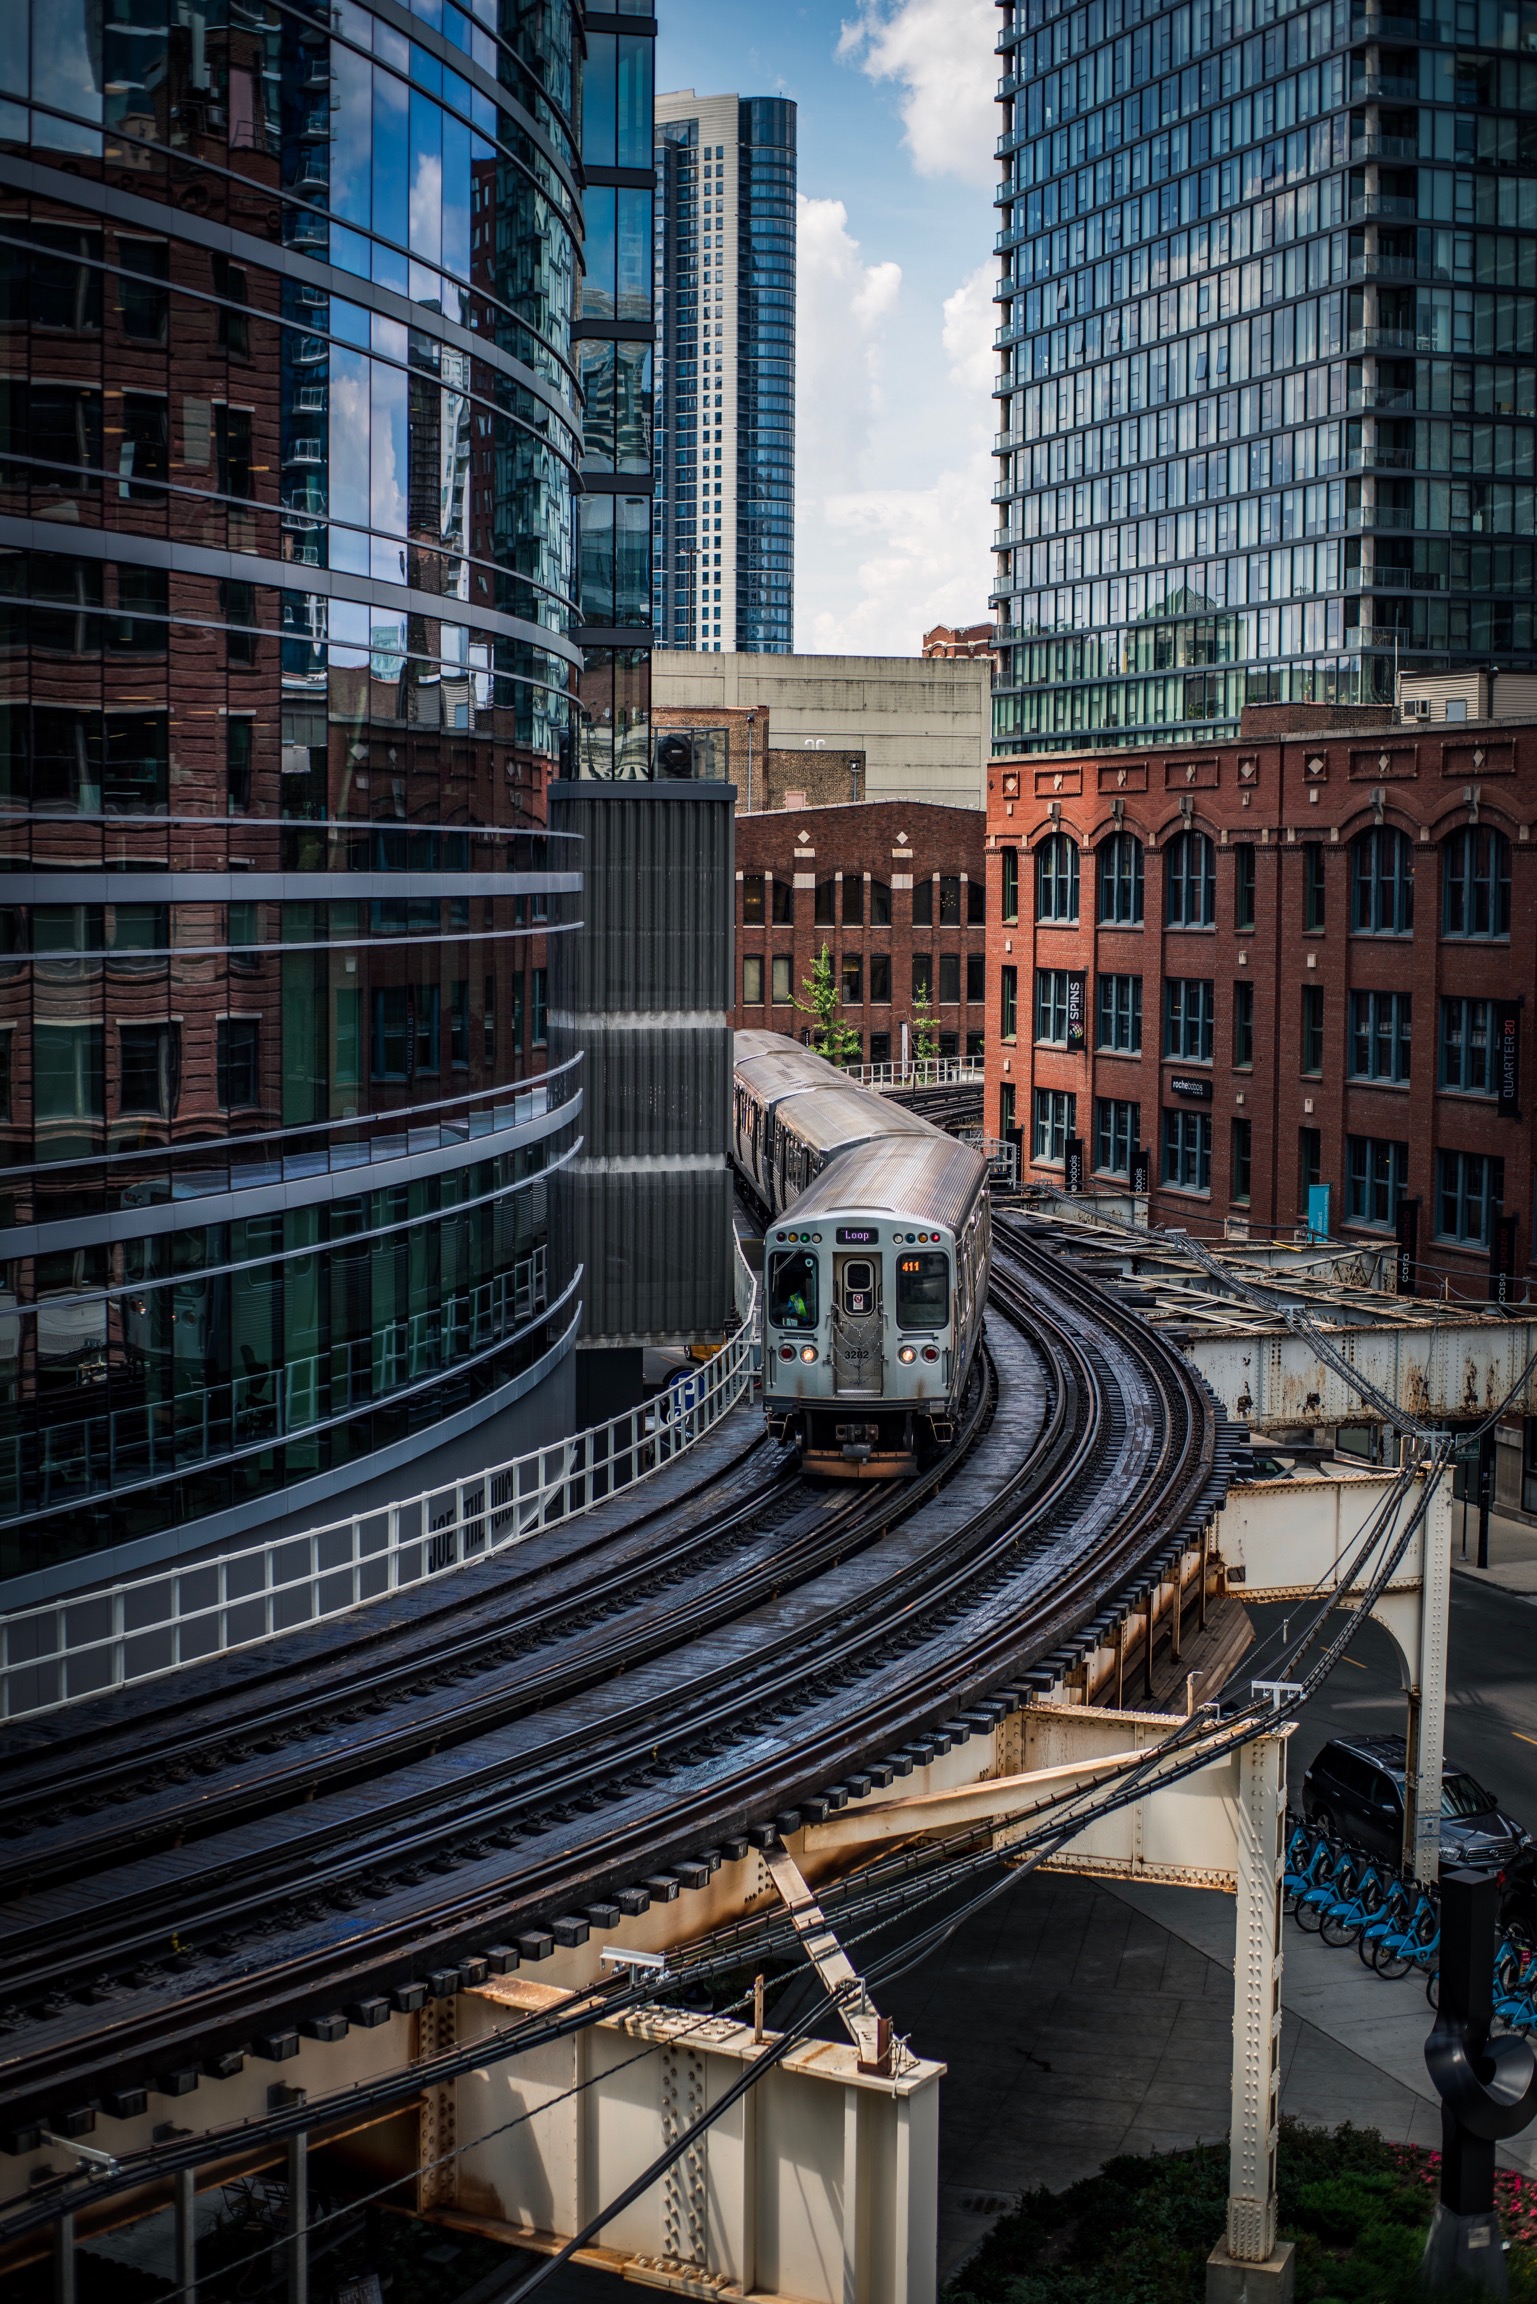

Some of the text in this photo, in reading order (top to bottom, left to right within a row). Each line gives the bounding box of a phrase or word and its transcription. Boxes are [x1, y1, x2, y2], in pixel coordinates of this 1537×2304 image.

[1069, 981, 1080, 1020] SPINS
[845, 1230, 870, 1242] Loop
[902, 1261, 919, 1272] 411
[1401, 1253, 1411, 1283] casa
[1498, 1272, 1507, 1304] casa
[844, 1350, 869, 1360] 3282
[678, 1377, 696, 1405] P
[429, 1508, 454, 1573] JOE
